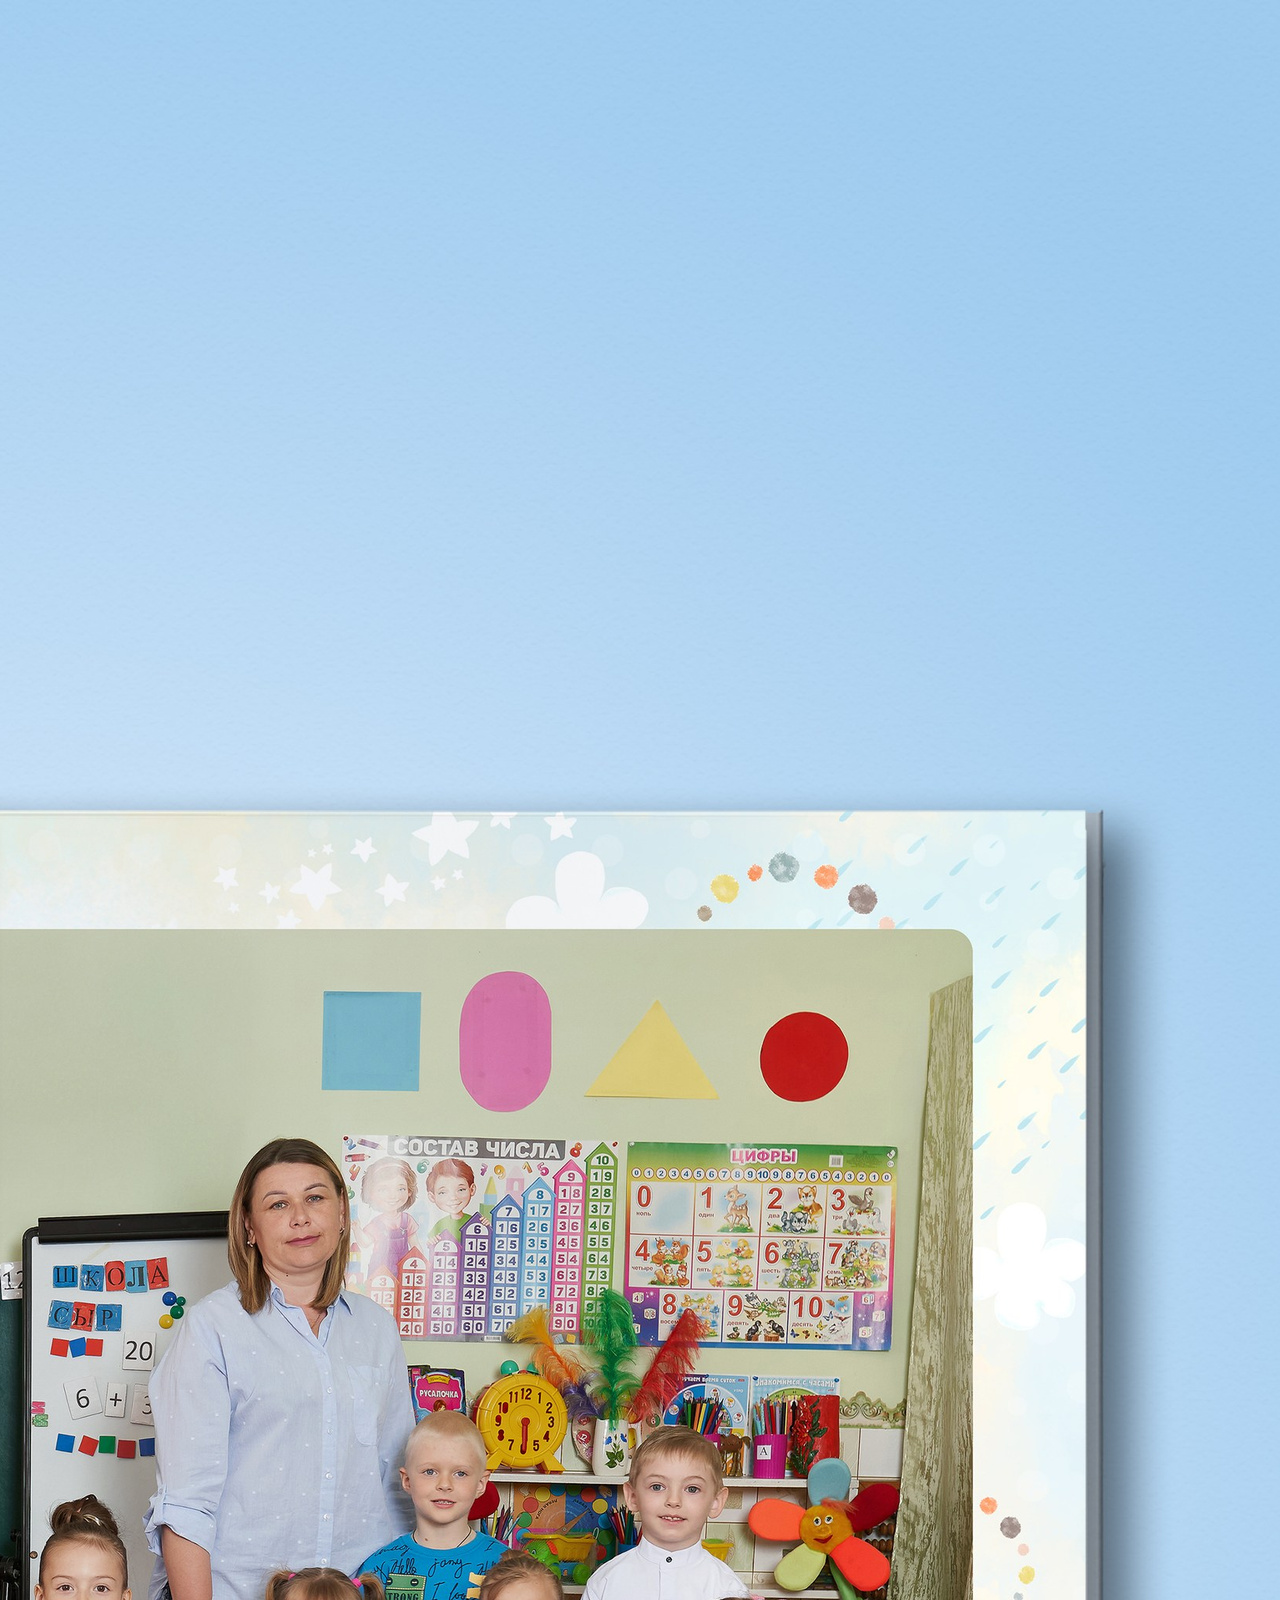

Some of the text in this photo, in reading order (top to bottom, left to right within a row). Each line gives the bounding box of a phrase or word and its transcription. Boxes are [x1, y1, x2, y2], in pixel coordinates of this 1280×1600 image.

[393, 1139, 560, 1159] СОСТАВ ЧИСЛА
[732, 1150, 797, 1165] ЦИФРЫ
[596, 1156, 609, 1165] 10
[637, 1185, 651, 1207] 0
[701, 1187, 712, 1208] 1
[768, 1188, 783, 1209] 2
[832, 1189, 845, 1211] 3
[635, 1240, 650, 1261] 4
[698, 1241, 712, 1262] 5
[765, 1242, 779, 1263] 6
[829, 1243, 843, 1264] 7
[56, 1265, 167, 1287] ШКОЛА
[662, 1294, 676, 1315] 8
[728, 1295, 742, 1316] 9
[794, 1296, 823, 1318] 10
[54, 1307, 113, 1327] СЫР
[125, 1340, 153, 1361] 20
[76, 1388, 90, 1408] 6
[420, 1390, 458, 1398] РУСАЛОЧКА
[509, 1391, 519, 1403] 11
[521, 1388, 532, 1400] 12
[538, 1392, 542, 1403] 1
[498, 1402, 508, 1414] 10
[546, 1402, 553, 1413] 2
[495, 1415, 502, 1426] 9
[548, 1417, 554, 1428] 3
[497, 1429, 505, 1441] 8
[508, 1439, 514, 1451] 7
[543, 1430, 550, 1442] 4
[533, 1440, 540, 1451] 5
